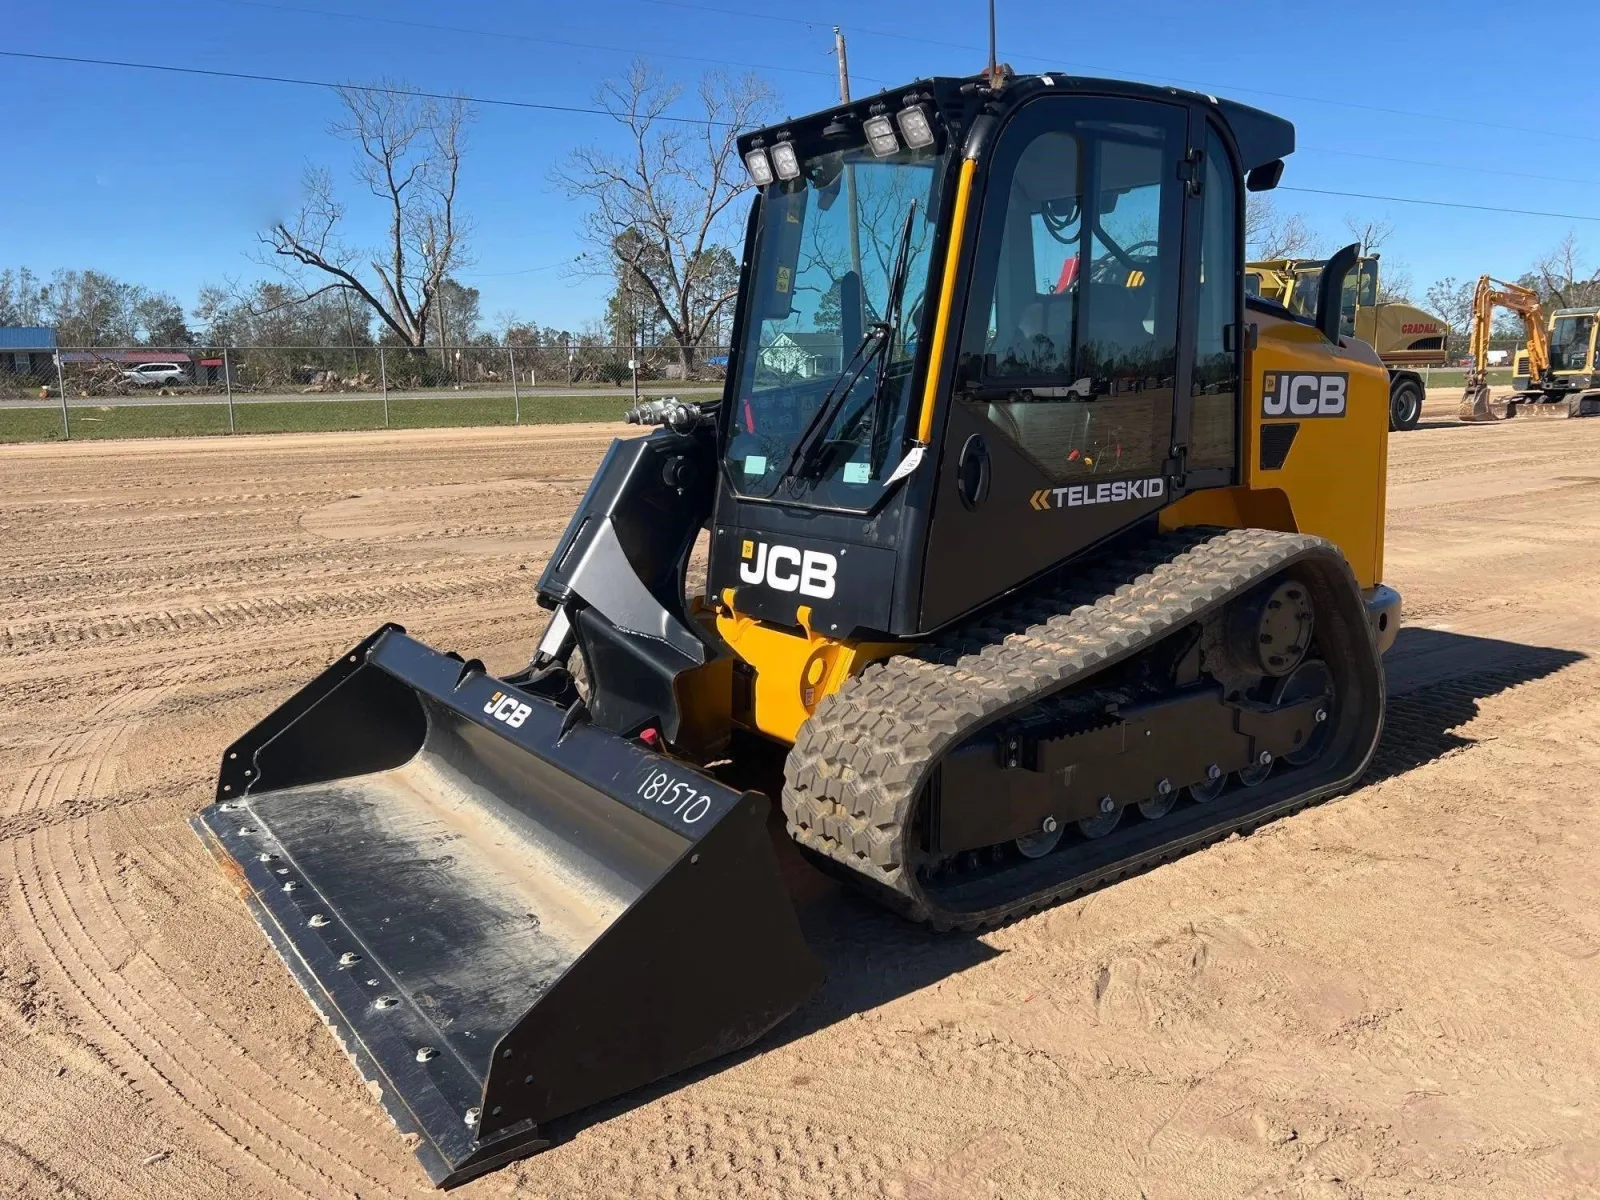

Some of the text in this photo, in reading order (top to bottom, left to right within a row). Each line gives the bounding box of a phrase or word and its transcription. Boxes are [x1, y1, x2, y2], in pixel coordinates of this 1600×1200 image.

[1401, 323, 1438, 334] GRADALL
[1263, 375, 1346, 415] JCB
[1052, 478, 1164, 508] TELESKID
[740, 541, 838, 600] JCB
[483, 693, 533, 728] JCB
[637, 768, 711, 823] 181570
